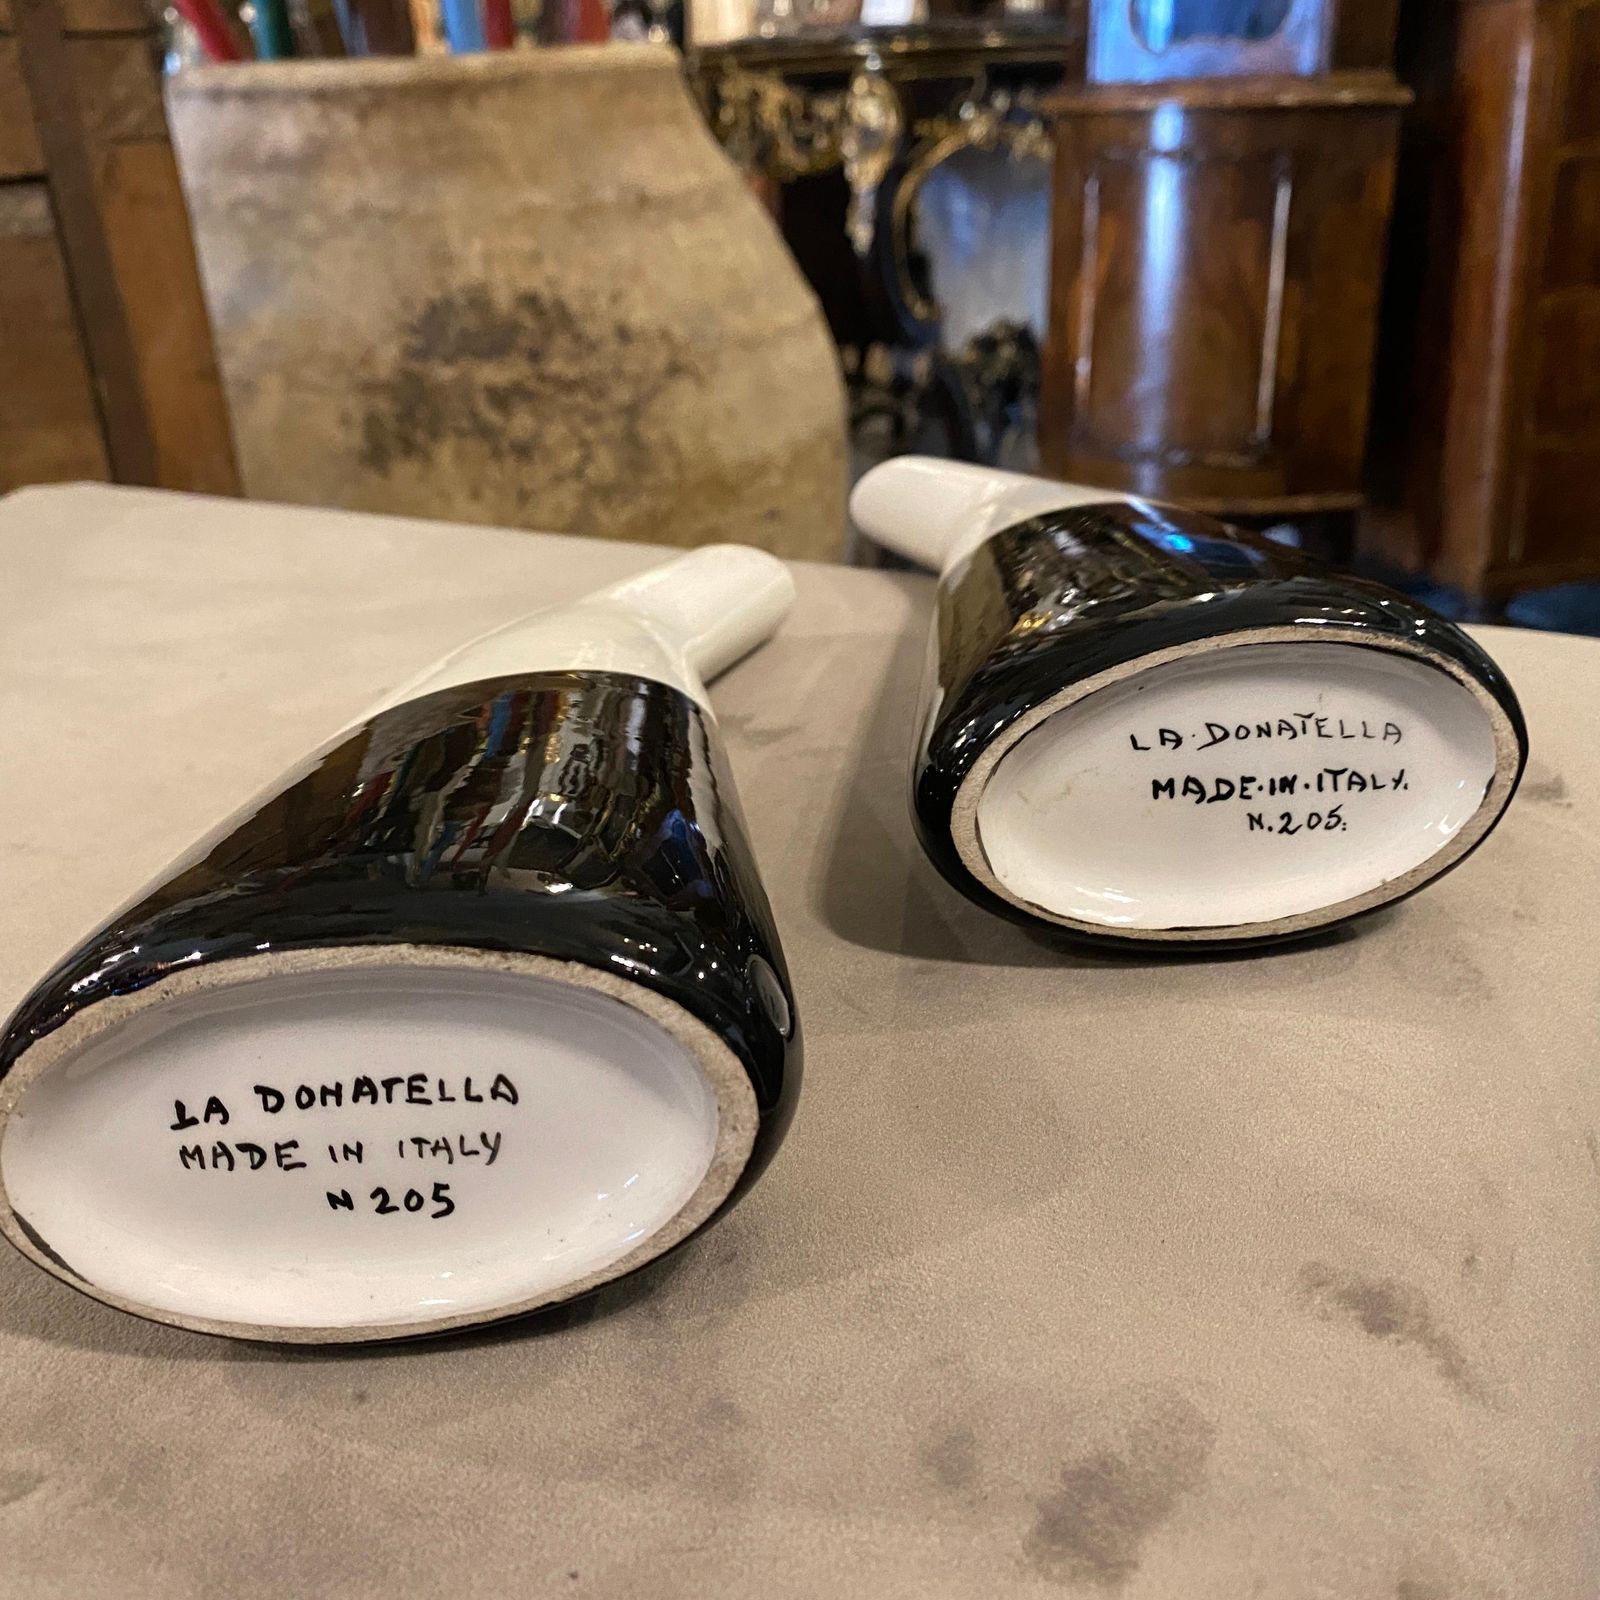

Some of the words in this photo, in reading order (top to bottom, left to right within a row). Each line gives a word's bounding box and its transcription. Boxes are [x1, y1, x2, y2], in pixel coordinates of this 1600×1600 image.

[1196, 711, 1403, 752] DONATELLA
[169, 1095, 230, 1132] LA
[252, 1072, 520, 1115] DONATELLA
[178, 1138, 308, 1172] MADE
[327, 1140, 364, 1165] IN
[397, 1130, 502, 1167] ITALY
[325, 1188, 355, 1212] N
[369, 1181, 456, 1220] 205
